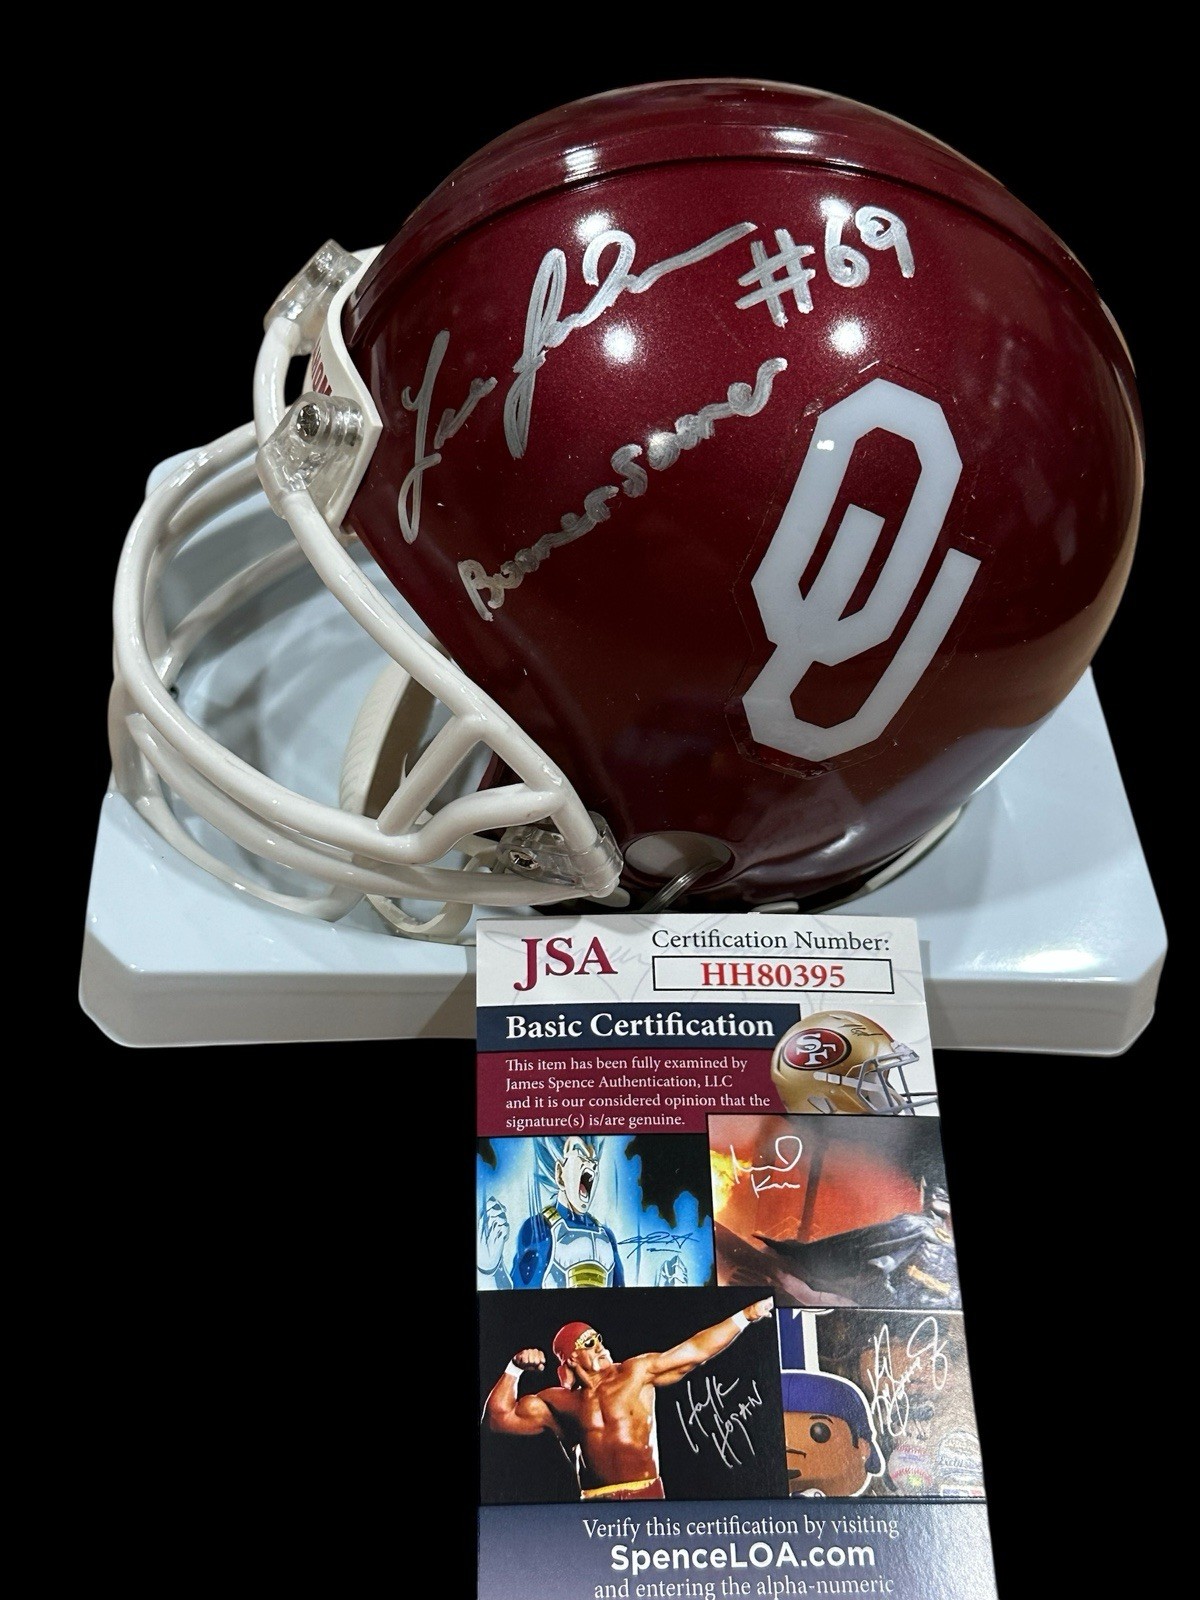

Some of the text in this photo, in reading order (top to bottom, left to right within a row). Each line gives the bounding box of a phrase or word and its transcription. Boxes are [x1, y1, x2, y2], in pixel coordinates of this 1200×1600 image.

[734, 203, 916, 329] #69
[651, 929, 890, 951] Certification Number:
[513, 935, 619, 992] JSA
[700, 962, 846, 988] HH80395
[505, 1011, 776, 1040] Basic Certification
[505, 1055, 748, 1073] This item has been fully examined by
[505, 1075, 733, 1092] James Spence Authentication, LLC
[505, 1094, 770, 1111] and it is our considered opinion that the
[505, 1112, 686, 1131] signature(s) is/are genuine.
[583, 1514, 900, 1542] Verify this certification by visiting
[610, 1541, 876, 1576] SpenceLOA.com
[594, 1574, 895, 1600] and entering the alpha-numeric
